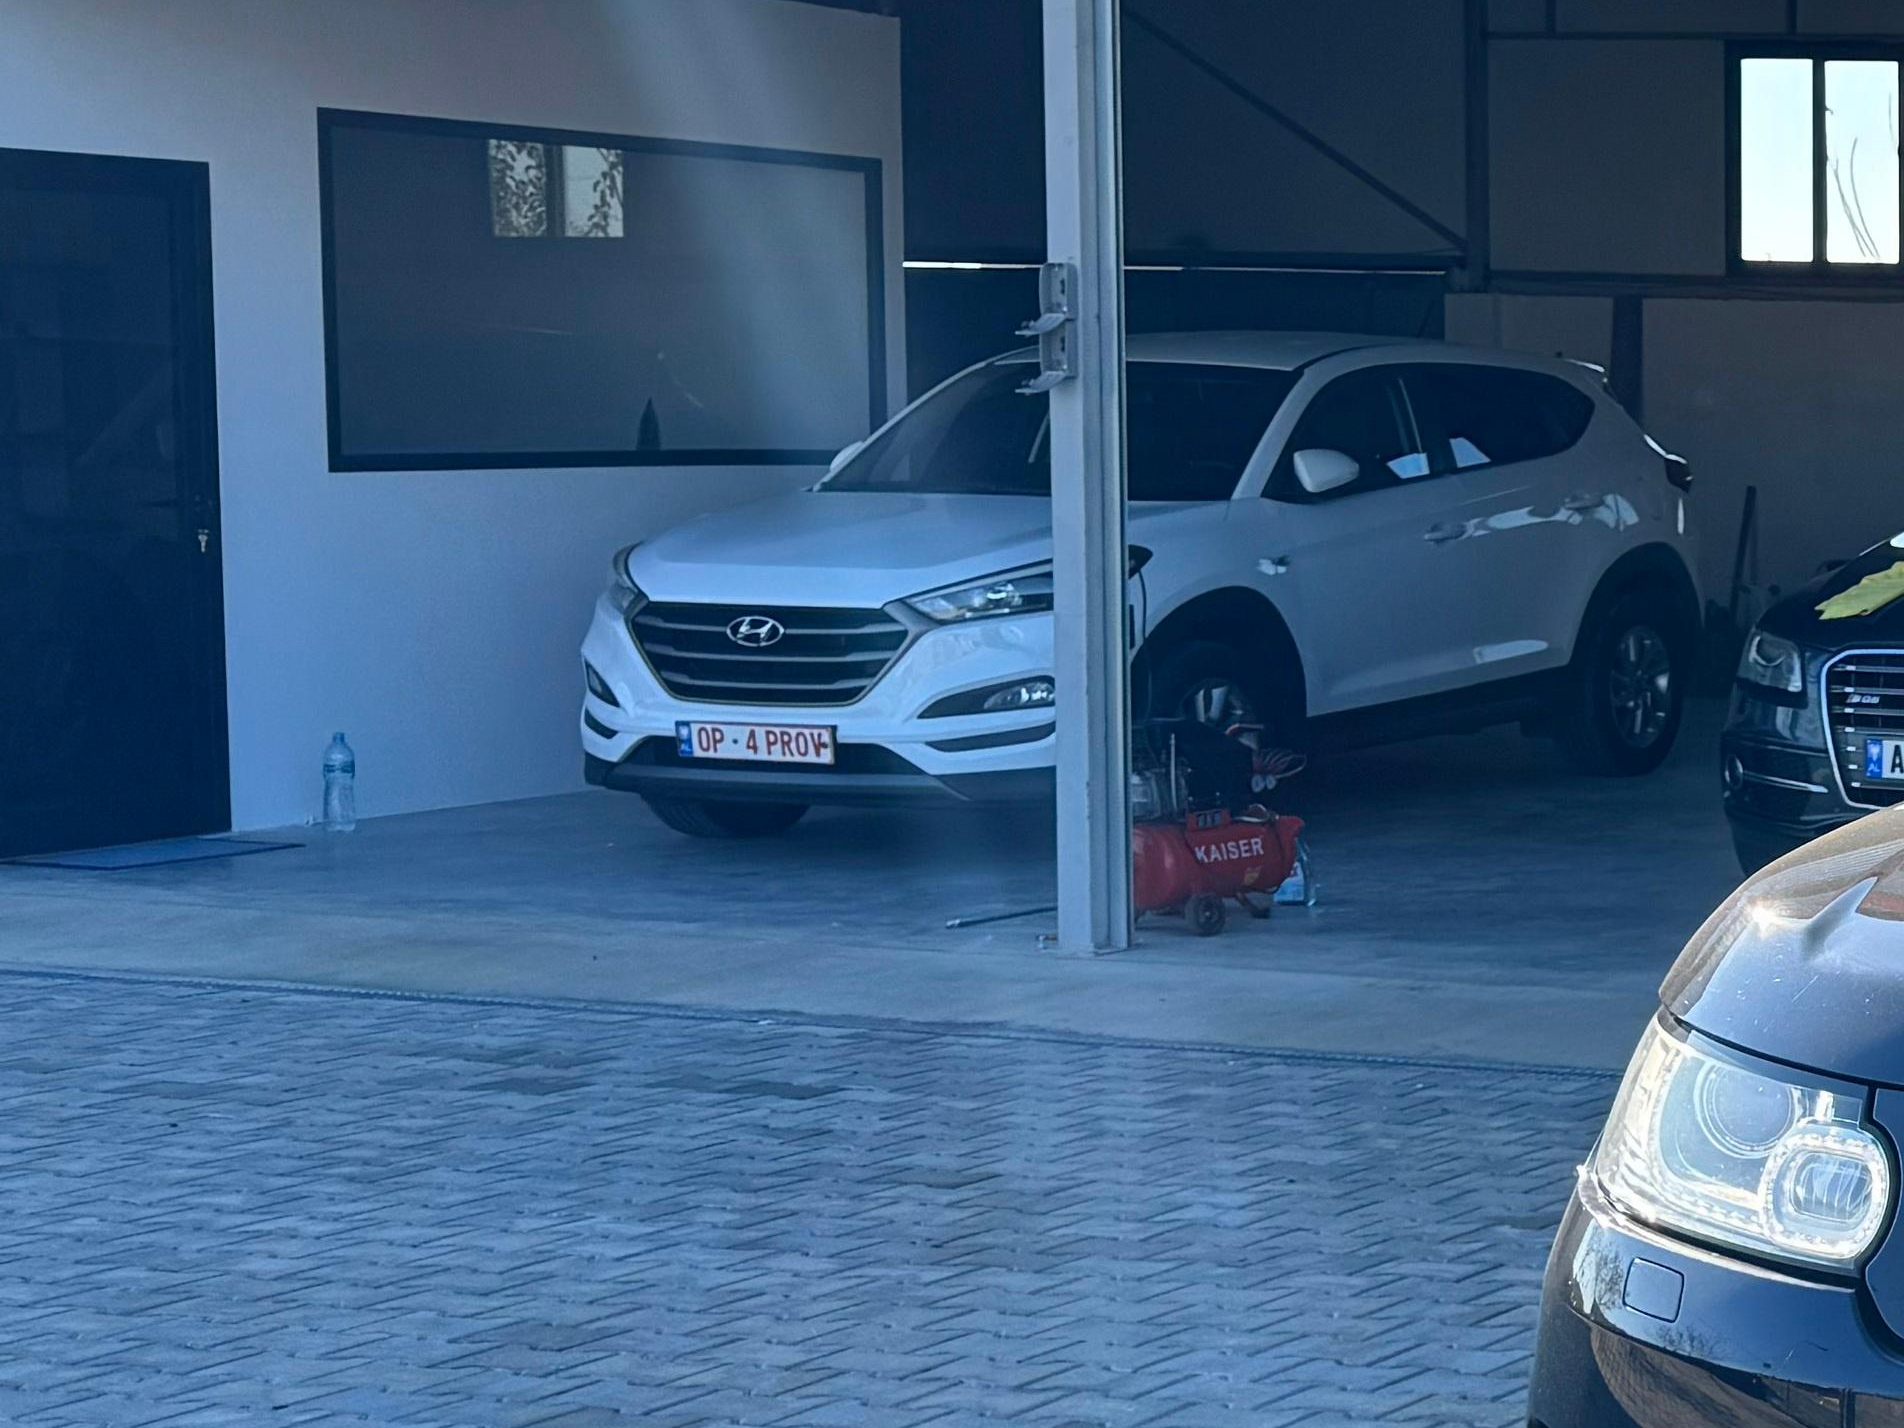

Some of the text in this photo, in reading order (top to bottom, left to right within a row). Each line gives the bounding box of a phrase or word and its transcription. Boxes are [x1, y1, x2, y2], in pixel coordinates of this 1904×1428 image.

[697, 727, 823, 758] OP 4 PROV
[1194, 837, 1265, 863] KAISER
